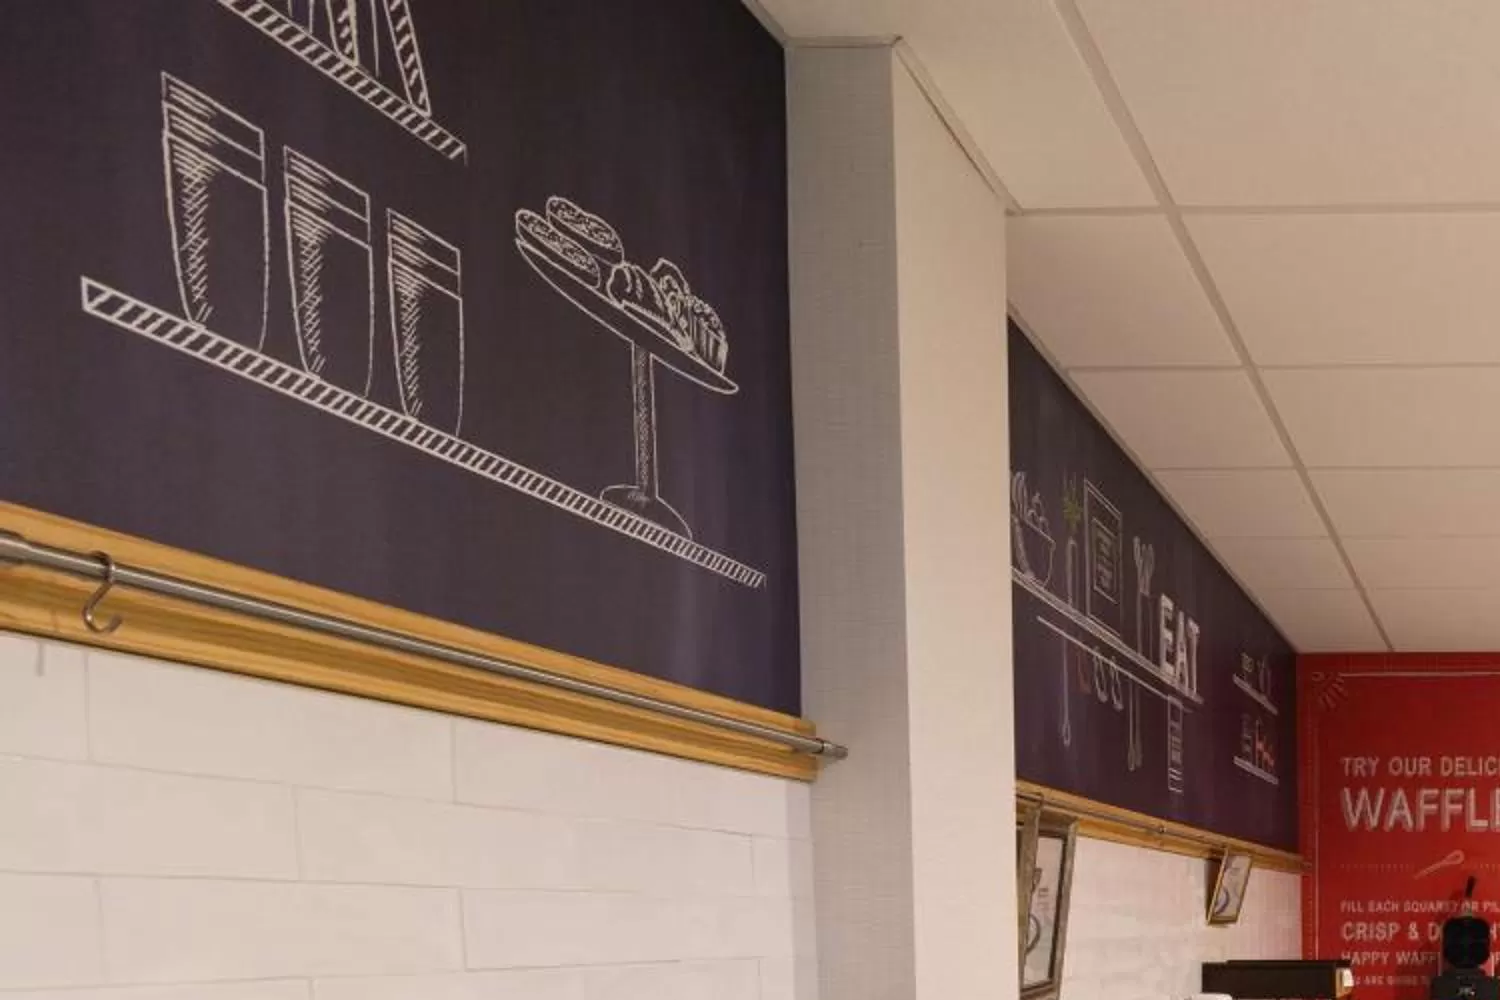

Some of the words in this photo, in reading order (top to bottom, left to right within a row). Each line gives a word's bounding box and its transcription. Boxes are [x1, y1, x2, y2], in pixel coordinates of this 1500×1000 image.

[1160, 593, 1200, 694] EAT
[1342, 757, 1379, 776] TRY
[1389, 757, 1431, 776] OUR
[1368, 900, 1399, 913] EACH
[1342, 921, 1400, 940] CRISP
[1408, 921, 1419, 940] &
